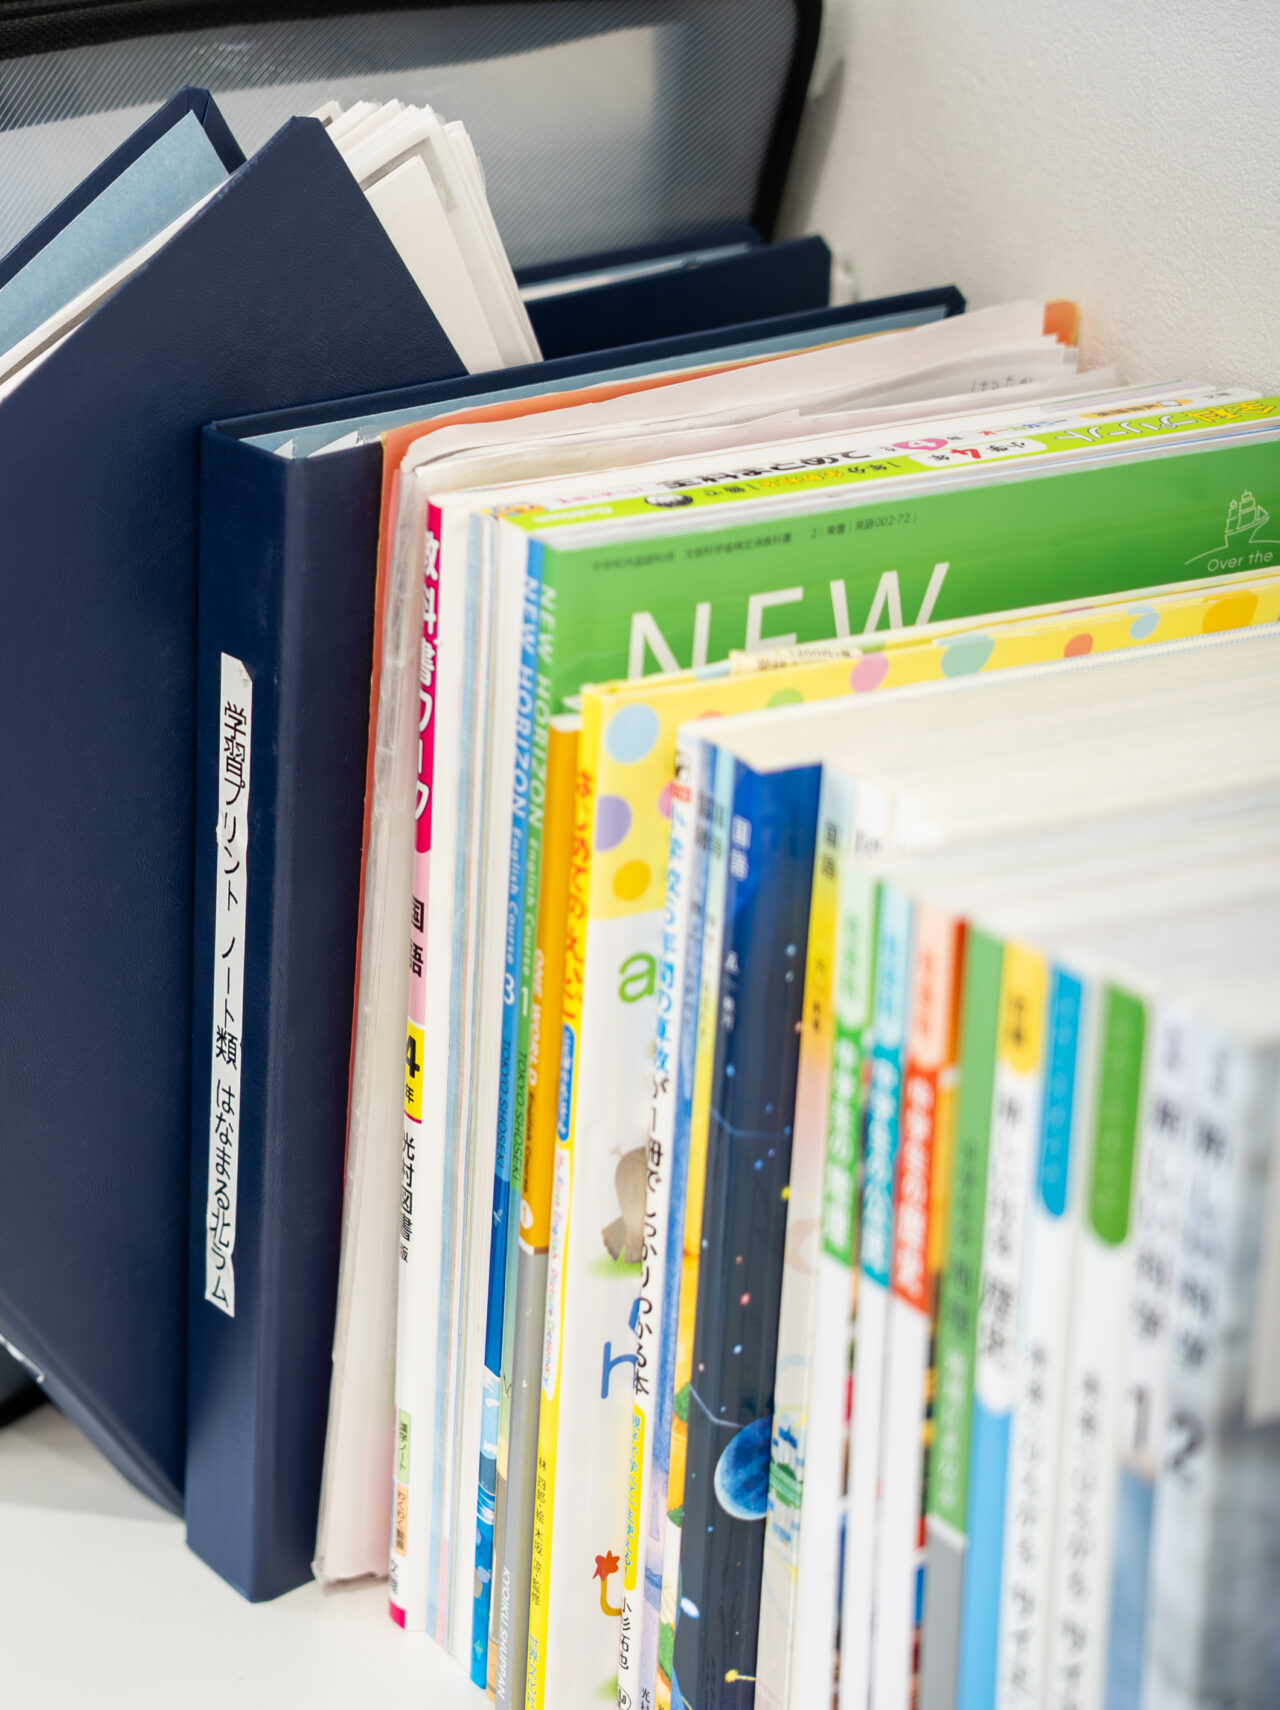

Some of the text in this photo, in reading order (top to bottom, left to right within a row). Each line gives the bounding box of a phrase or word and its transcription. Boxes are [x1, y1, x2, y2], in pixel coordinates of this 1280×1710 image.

[1206, 550, 1274, 573] Over the
[503, 574, 540, 1006] NEW HORIZON English Course 3
[521, 583, 558, 1017] NEW HORIZON English Course 1
[533, 947, 545, 1000] ONE
[496, 1038, 512, 1169] TOKYO SHOSEKI
[528, 1003, 542, 1087] WORLD
[511, 1051, 528, 1183] TOKYO SHOSEKI
[495, 1566, 512, 1702] KYOIKU SHUPPAN
